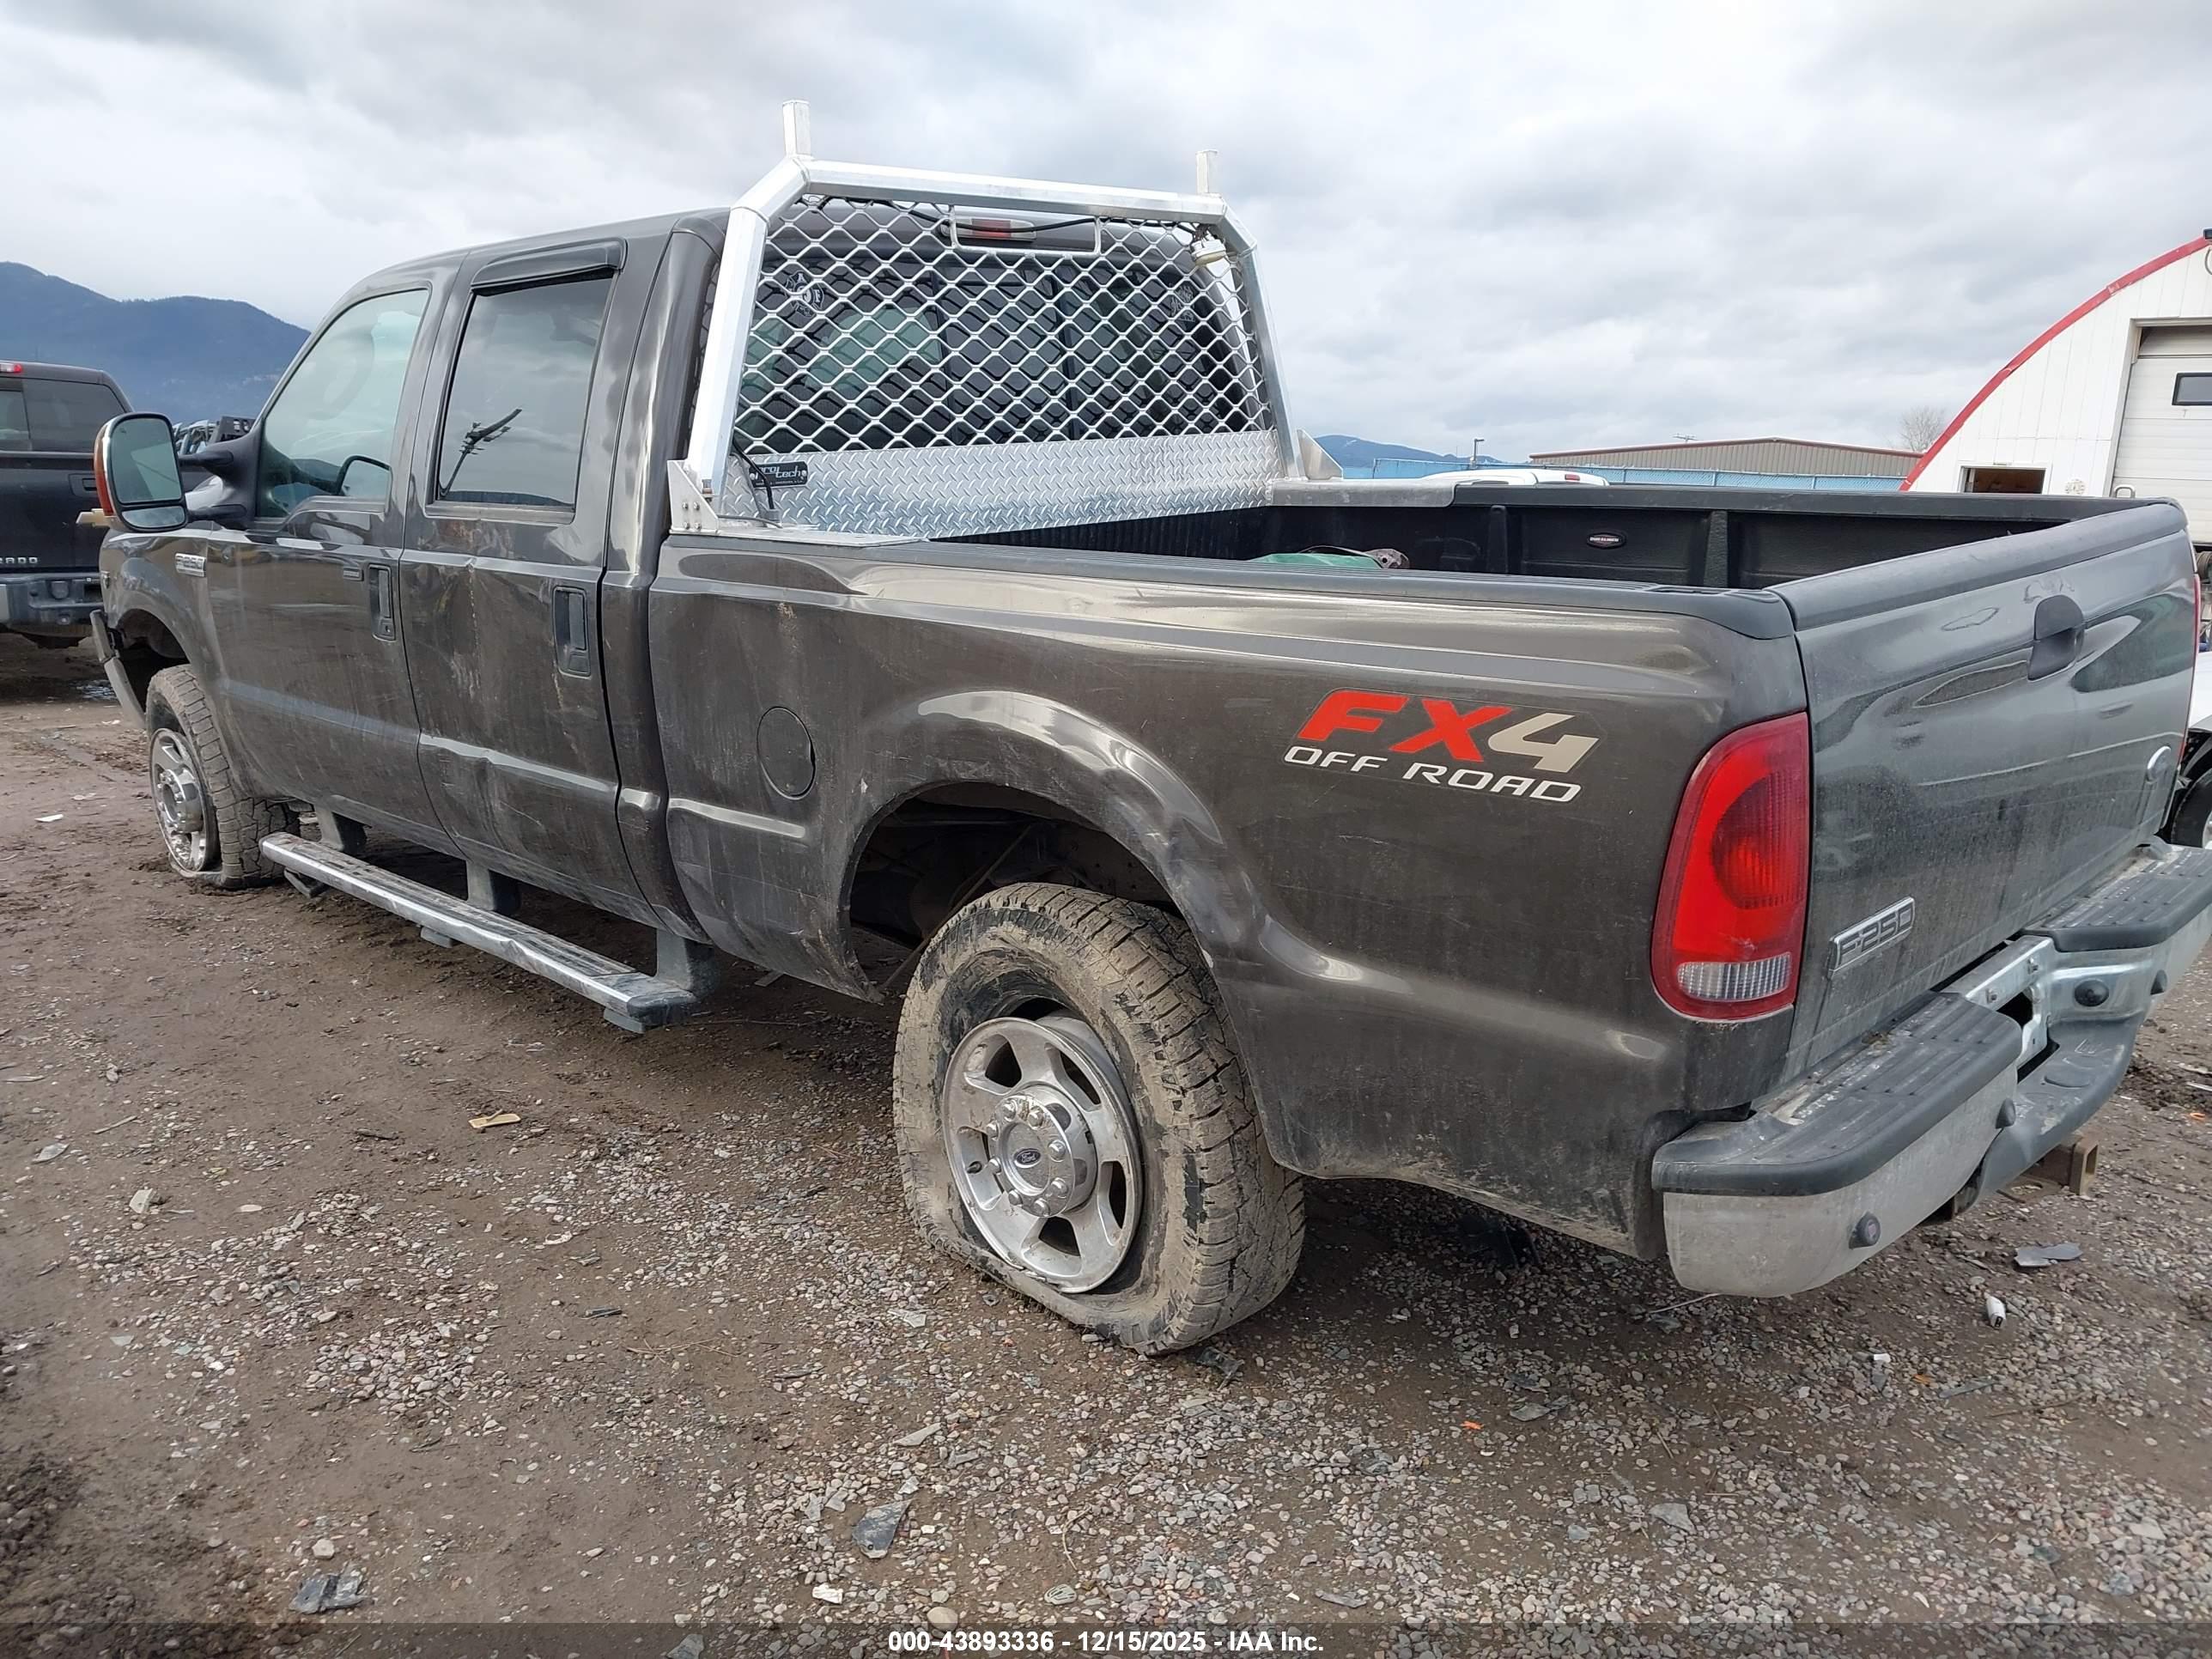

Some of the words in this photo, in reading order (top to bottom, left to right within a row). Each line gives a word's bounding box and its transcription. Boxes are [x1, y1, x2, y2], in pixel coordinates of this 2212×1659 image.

[775, 465, 801, 478] tech
[1297, 690, 1600, 773] FX4
[1284, 745, 1388, 772] OFF
[1402, 763, 1582, 802] ROAD
